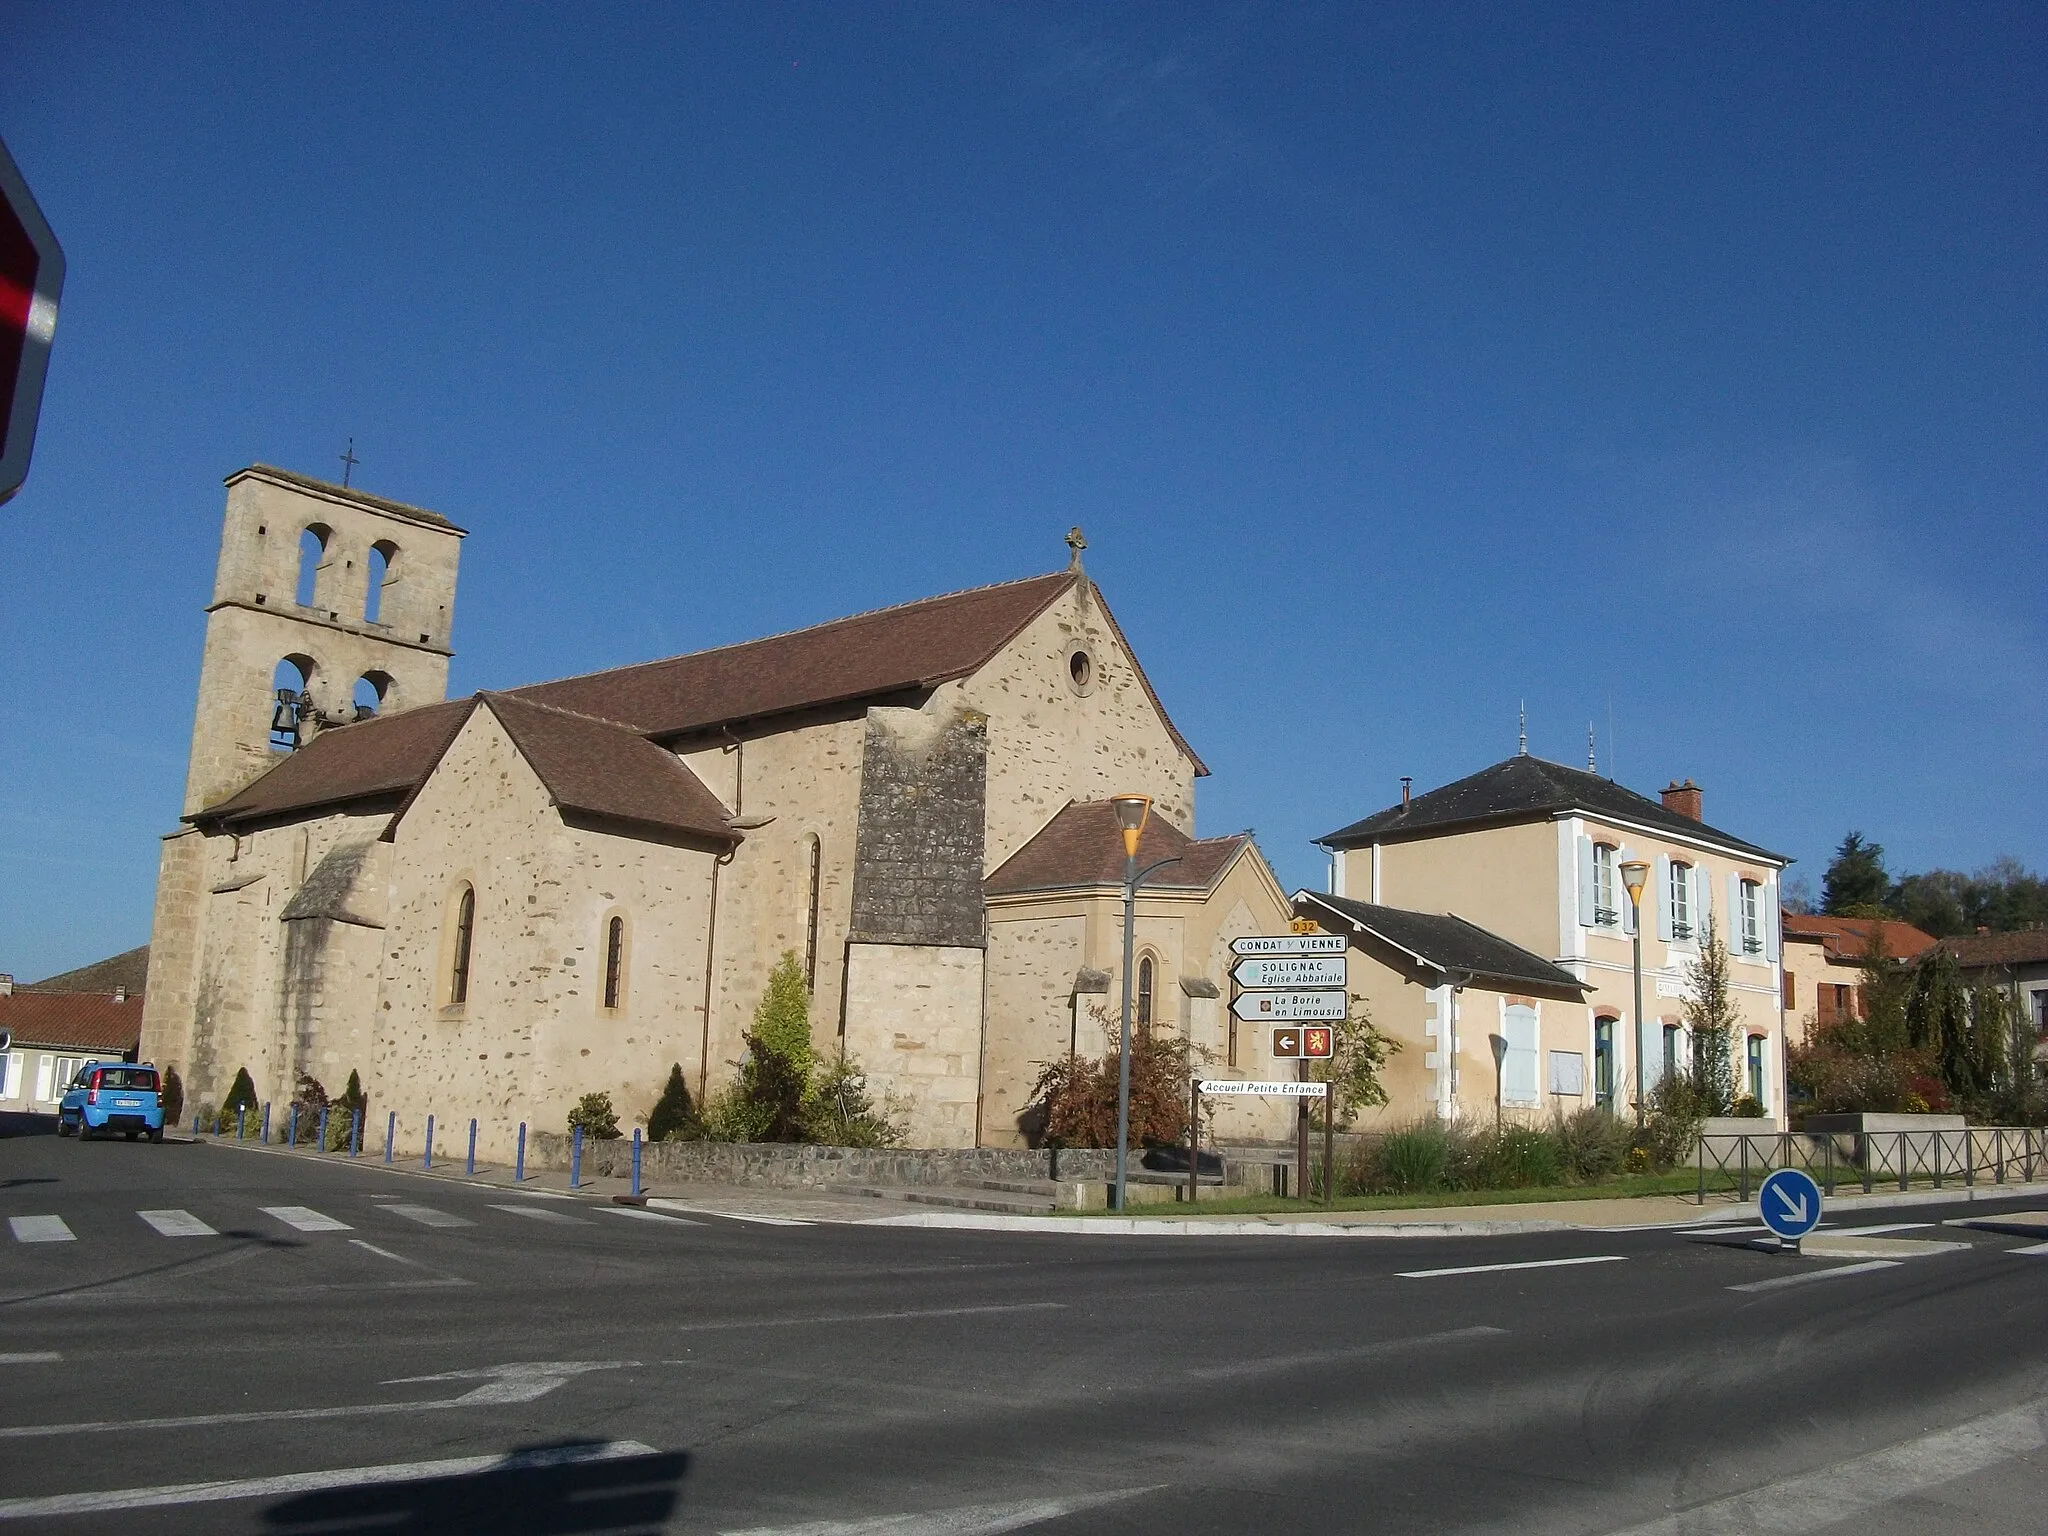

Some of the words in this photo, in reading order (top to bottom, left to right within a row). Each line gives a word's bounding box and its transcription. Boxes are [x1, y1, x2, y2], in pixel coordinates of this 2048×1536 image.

[1293, 923, 1299, 932] D
[1302, 922, 1315, 931] 32
[1240, 941, 1282, 950] CONDAT
[1300, 940, 1341, 949] VIENNE
[1262, 962, 1323, 972] SOLIGNAC
[1262, 974, 1291, 985] Eglise
[1295, 973, 1342, 983] Abbatiale
[1274, 996, 1286, 1005] La
[1292, 995, 1321, 1005] Borie
[1293, 1007, 1342, 1016] Limousin
[1205, 1082, 1244, 1092] Accueil
[1247, 1083, 1278, 1093] Petite
[1282, 1083, 1324, 1094] Enfance
